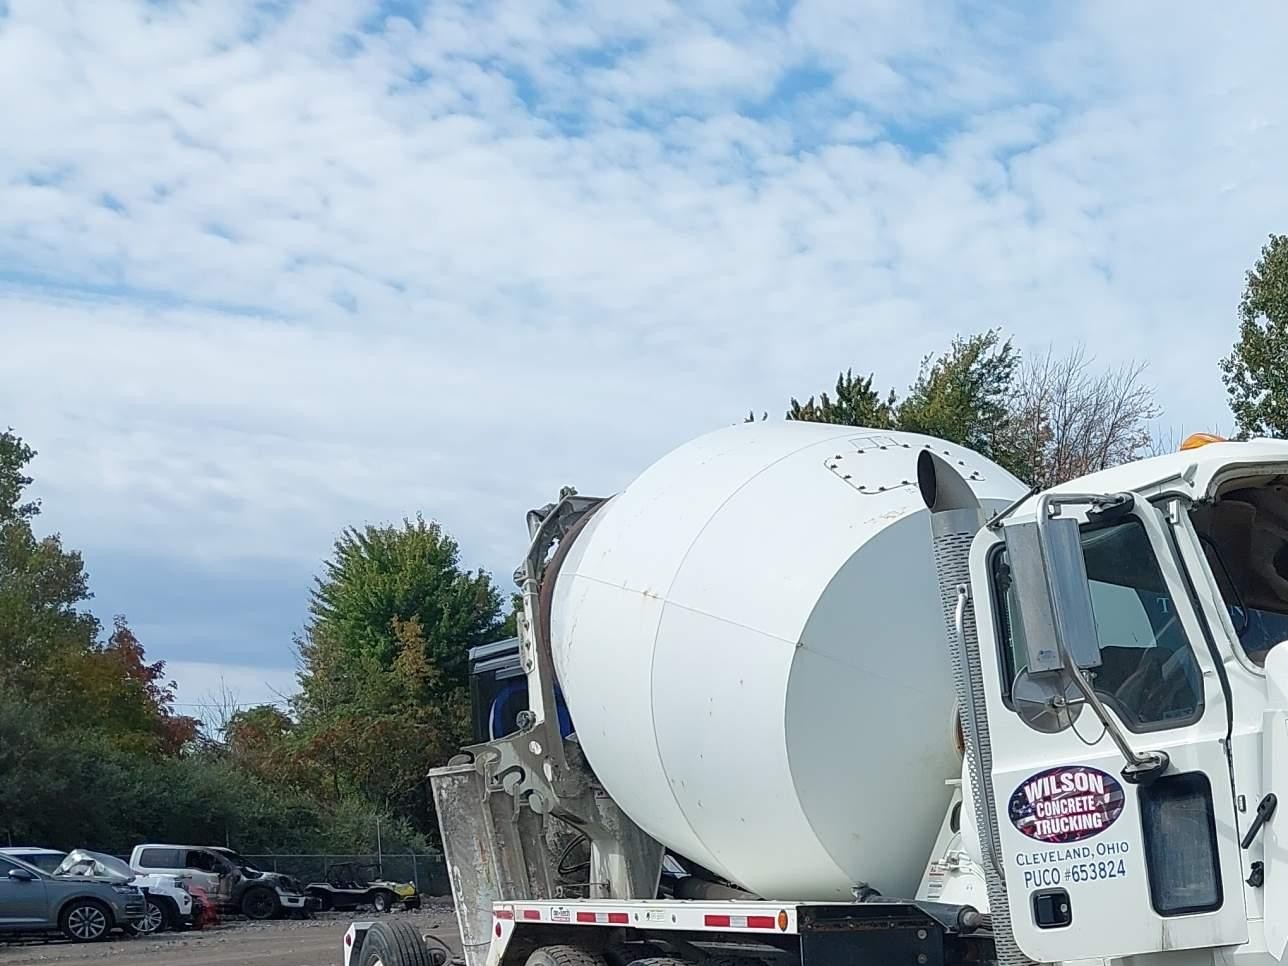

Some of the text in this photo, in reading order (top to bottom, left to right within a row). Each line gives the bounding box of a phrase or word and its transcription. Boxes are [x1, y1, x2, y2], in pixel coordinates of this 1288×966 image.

[1024, 772, 1105, 804] WILSON
[1036, 795, 1096, 818] CONCRETE
[1034, 812, 1102, 836] TRUCKING
[1024, 859, 1126, 888] PUCO #653824
